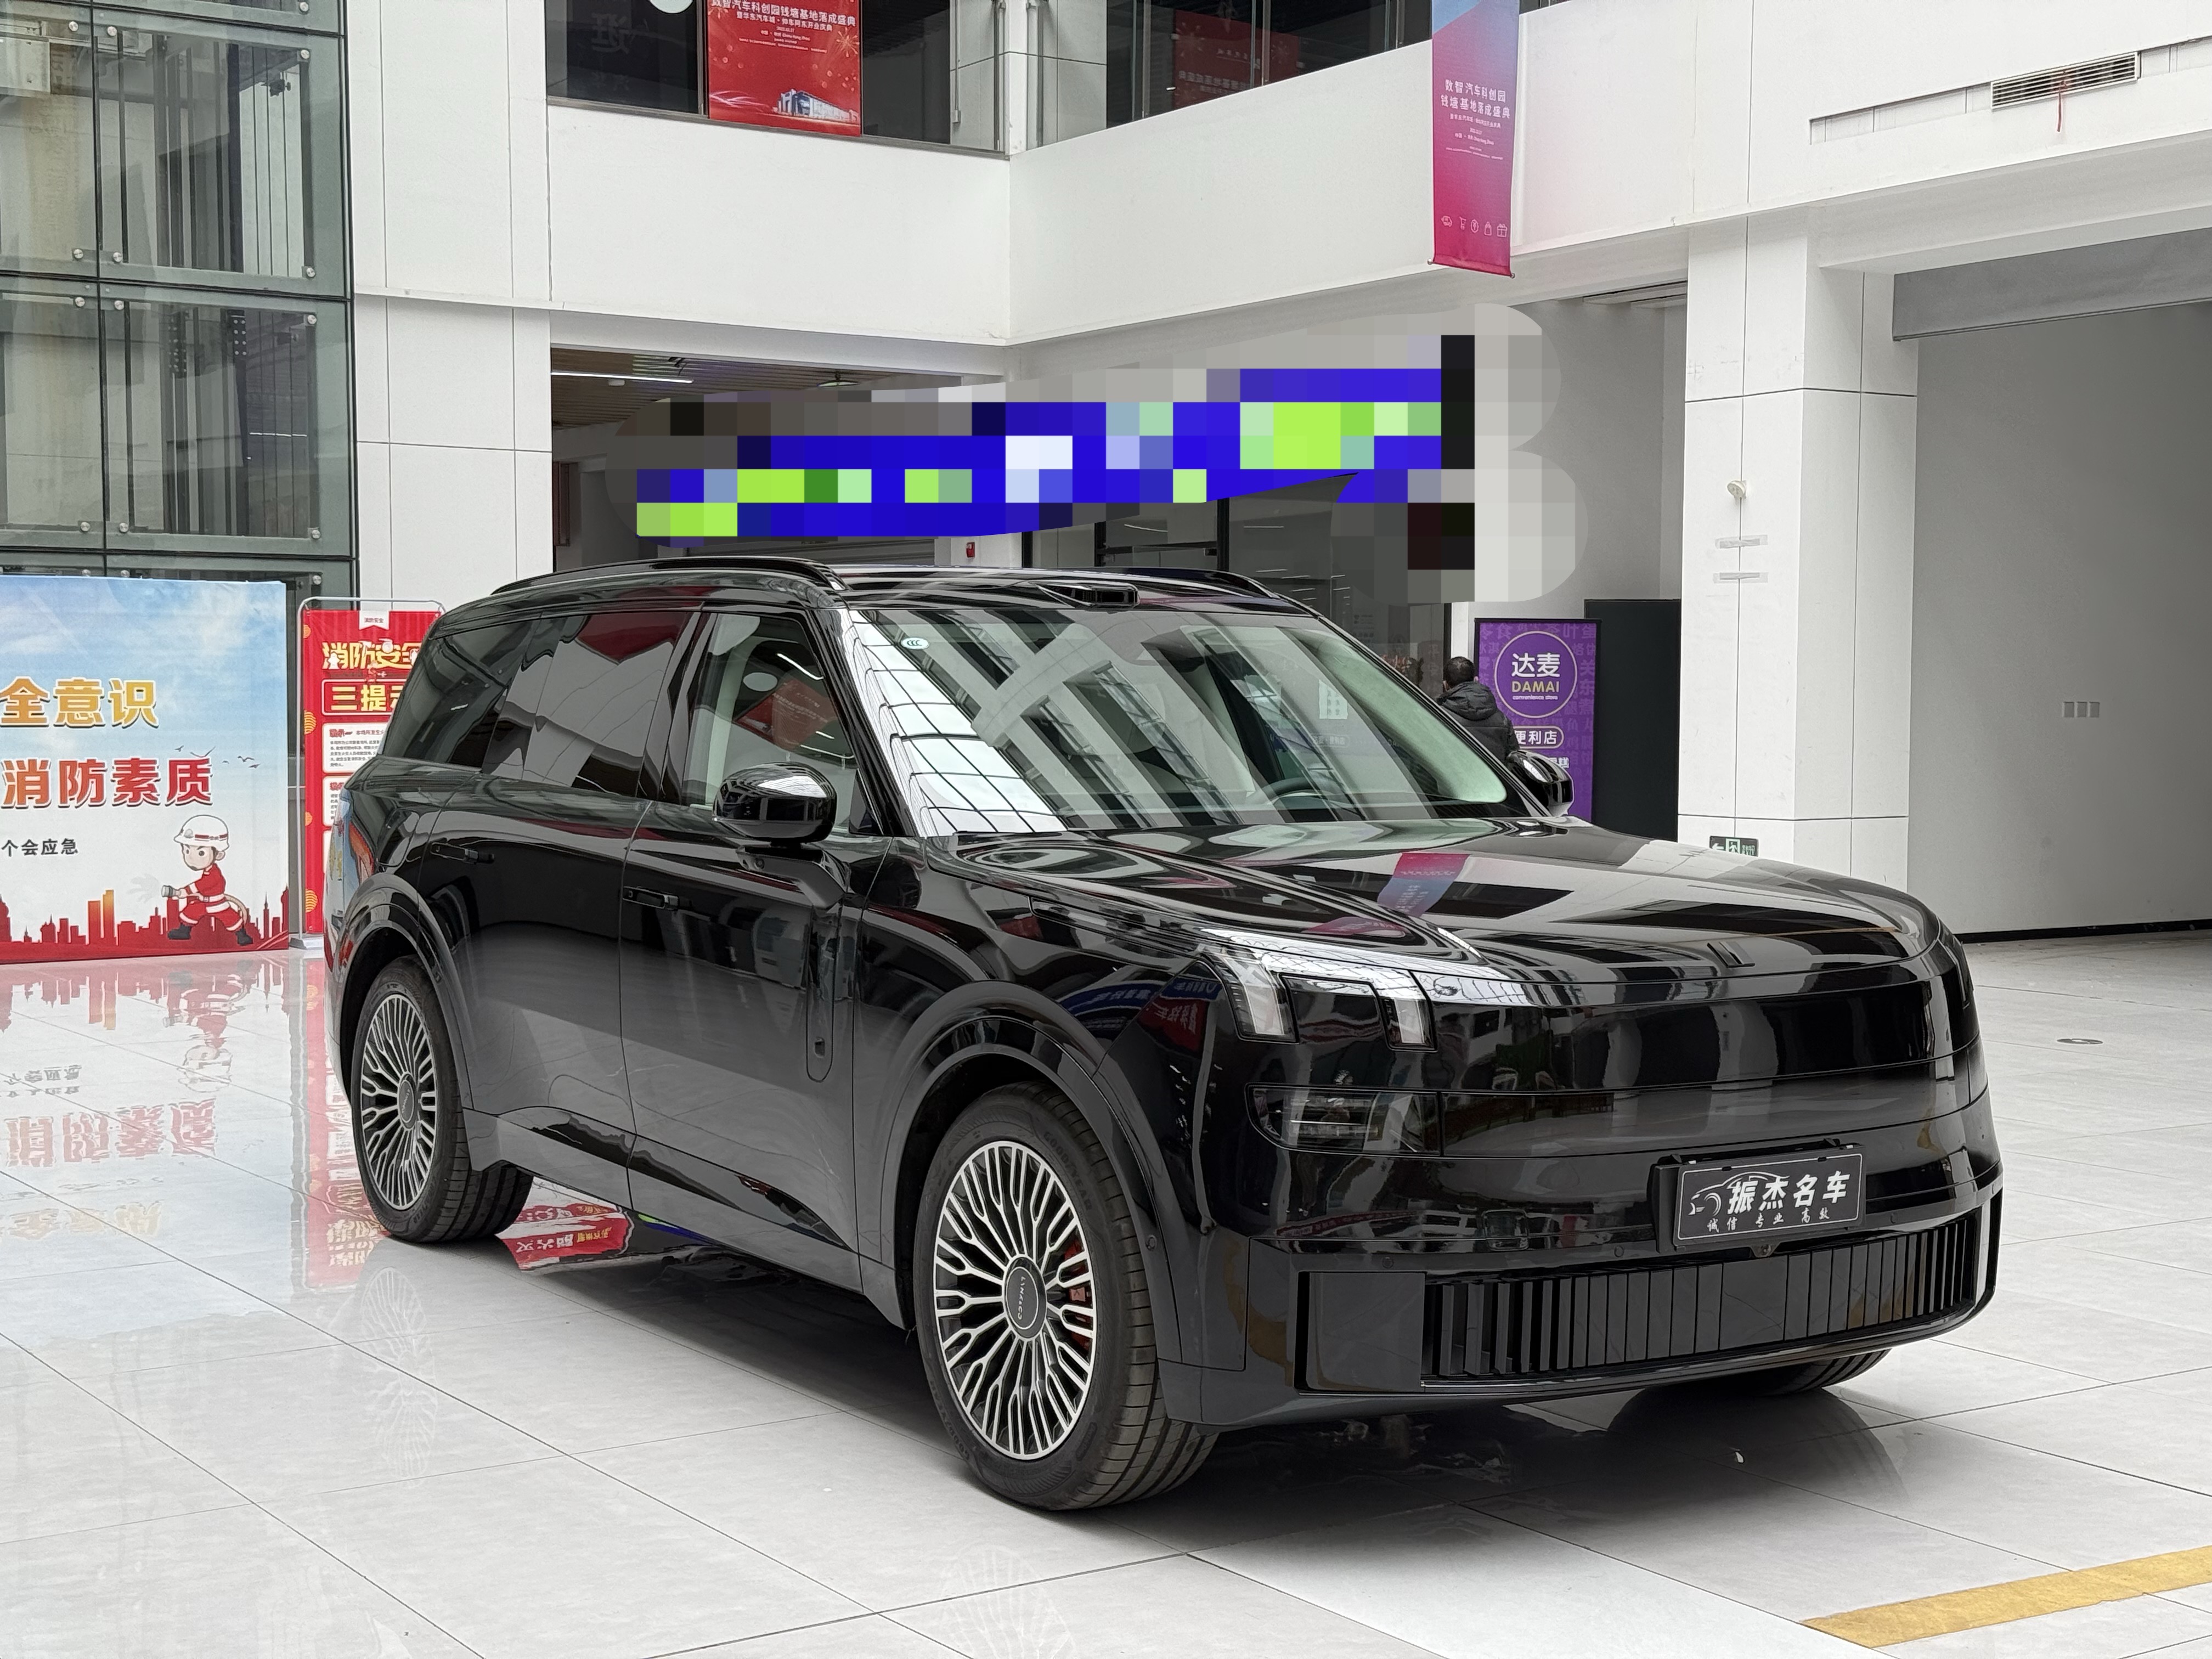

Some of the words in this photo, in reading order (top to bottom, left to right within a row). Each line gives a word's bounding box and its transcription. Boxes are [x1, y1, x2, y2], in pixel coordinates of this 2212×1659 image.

[1511, 652, 1560, 678] 达麦
[1512, 681, 1559, 692] DAMAI
[0, 676, 159, 728] 全意识
[1515, 730, 1557, 745] 便利店
[1, 757, 213, 808] 消防素质
[1727, 1170, 1850, 1215] 振杰名车
[1707, 1216, 1737, 1233] 诚信
[1756, 1212, 1785, 1228] 专业
[1801, 1207, 1830, 1223] 高效
